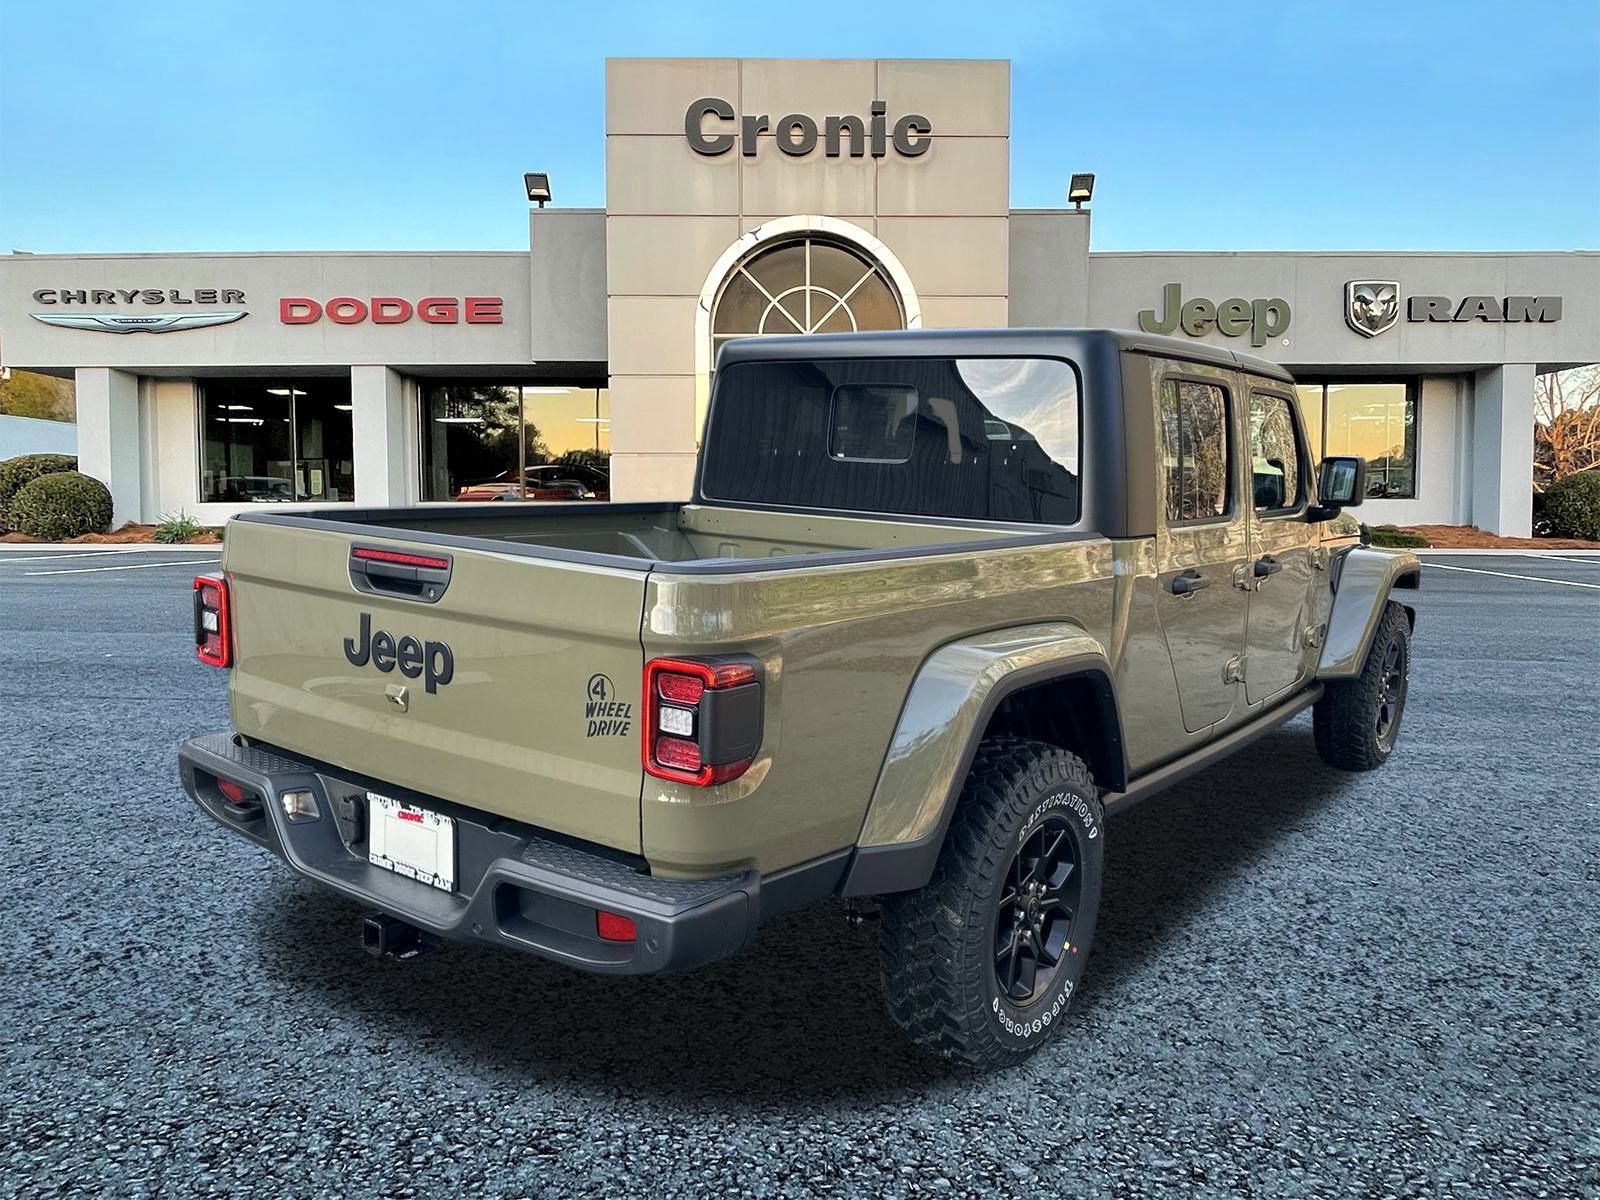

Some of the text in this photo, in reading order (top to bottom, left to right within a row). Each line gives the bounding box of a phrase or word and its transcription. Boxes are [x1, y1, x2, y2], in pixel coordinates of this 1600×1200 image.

[684, 97, 932, 158] Cronic
[32, 287, 248, 306] CHRYSLER
[1407, 295, 1563, 323] RAM
[279, 297, 504, 325] DODGE
[1139, 283, 1292, 347] Jeep
[343, 612, 454, 695] Jeep
[585, 701, 632, 719] WHEEL
[586, 719, 632, 738] DRIVE
